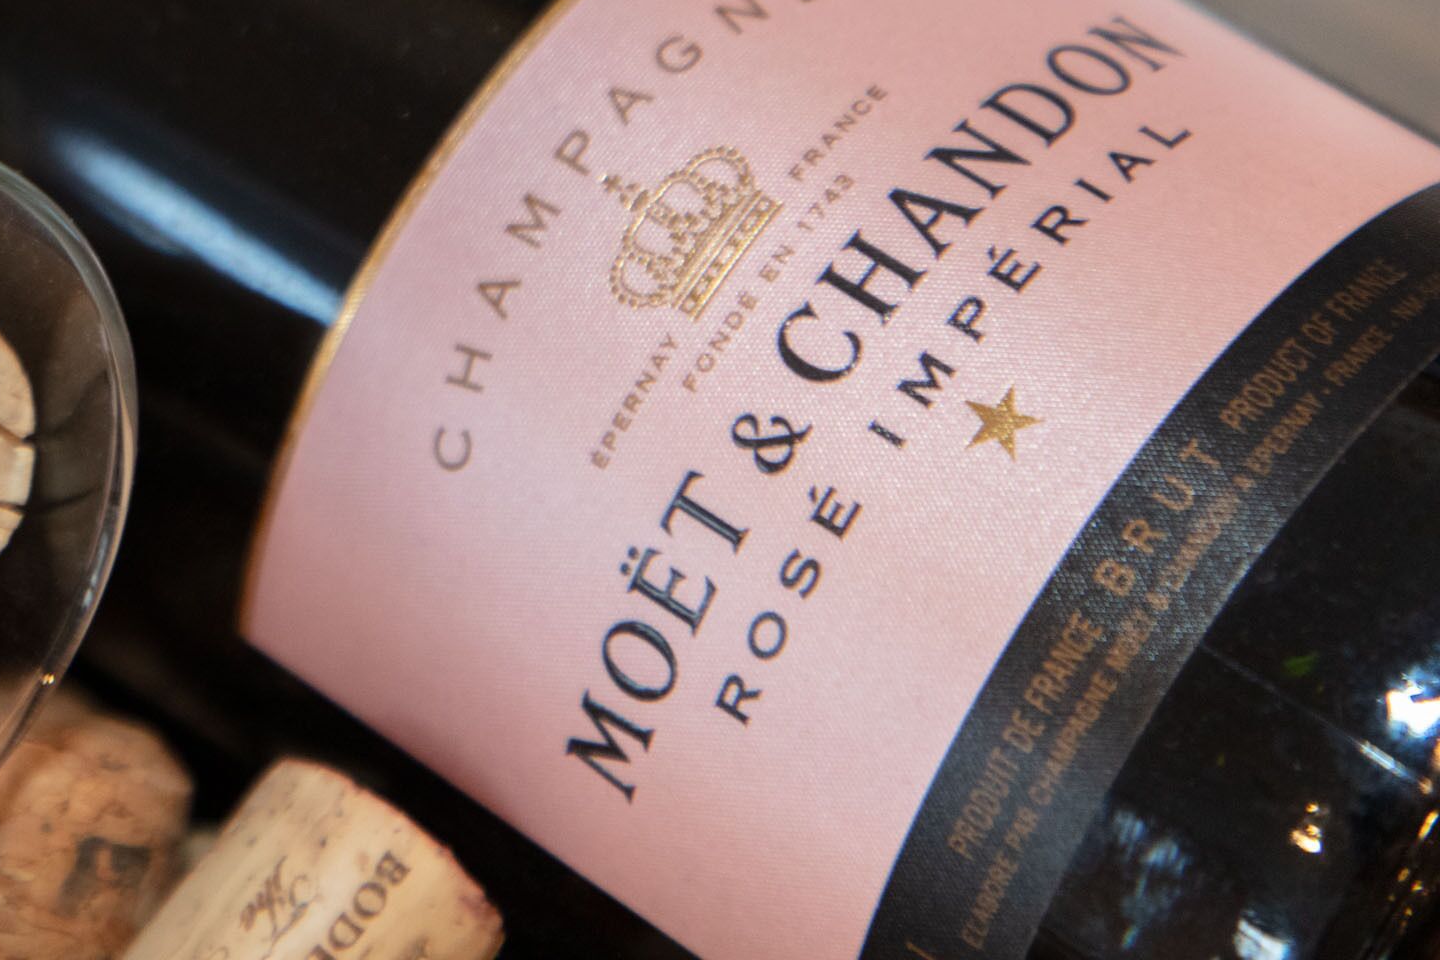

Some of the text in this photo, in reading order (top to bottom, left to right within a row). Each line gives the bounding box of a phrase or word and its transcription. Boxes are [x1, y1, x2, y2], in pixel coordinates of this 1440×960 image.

[759, 243, 796, 283] EN
[796, 172, 855, 232] 1743
[787, 83, 889, 183] FRANCE
[565, 15, 1188, 803] MOËT & CHANDON
[714, 120, 1194, 728] ROSÉ IMPÉRIAL
[1218, 336, 1316, 435] PRODUCT
[1302, 311, 1338, 345] OF
[1325, 256, 1408, 322] FRANCE
[1028, 670, 1118, 806] CHAMPAGNE
[1324, 325, 1394, 387] FRANCE
[1093, 437, 1221, 597] BRUT
[947, 608, 1104, 861] PRODUIT DE FRANCE
